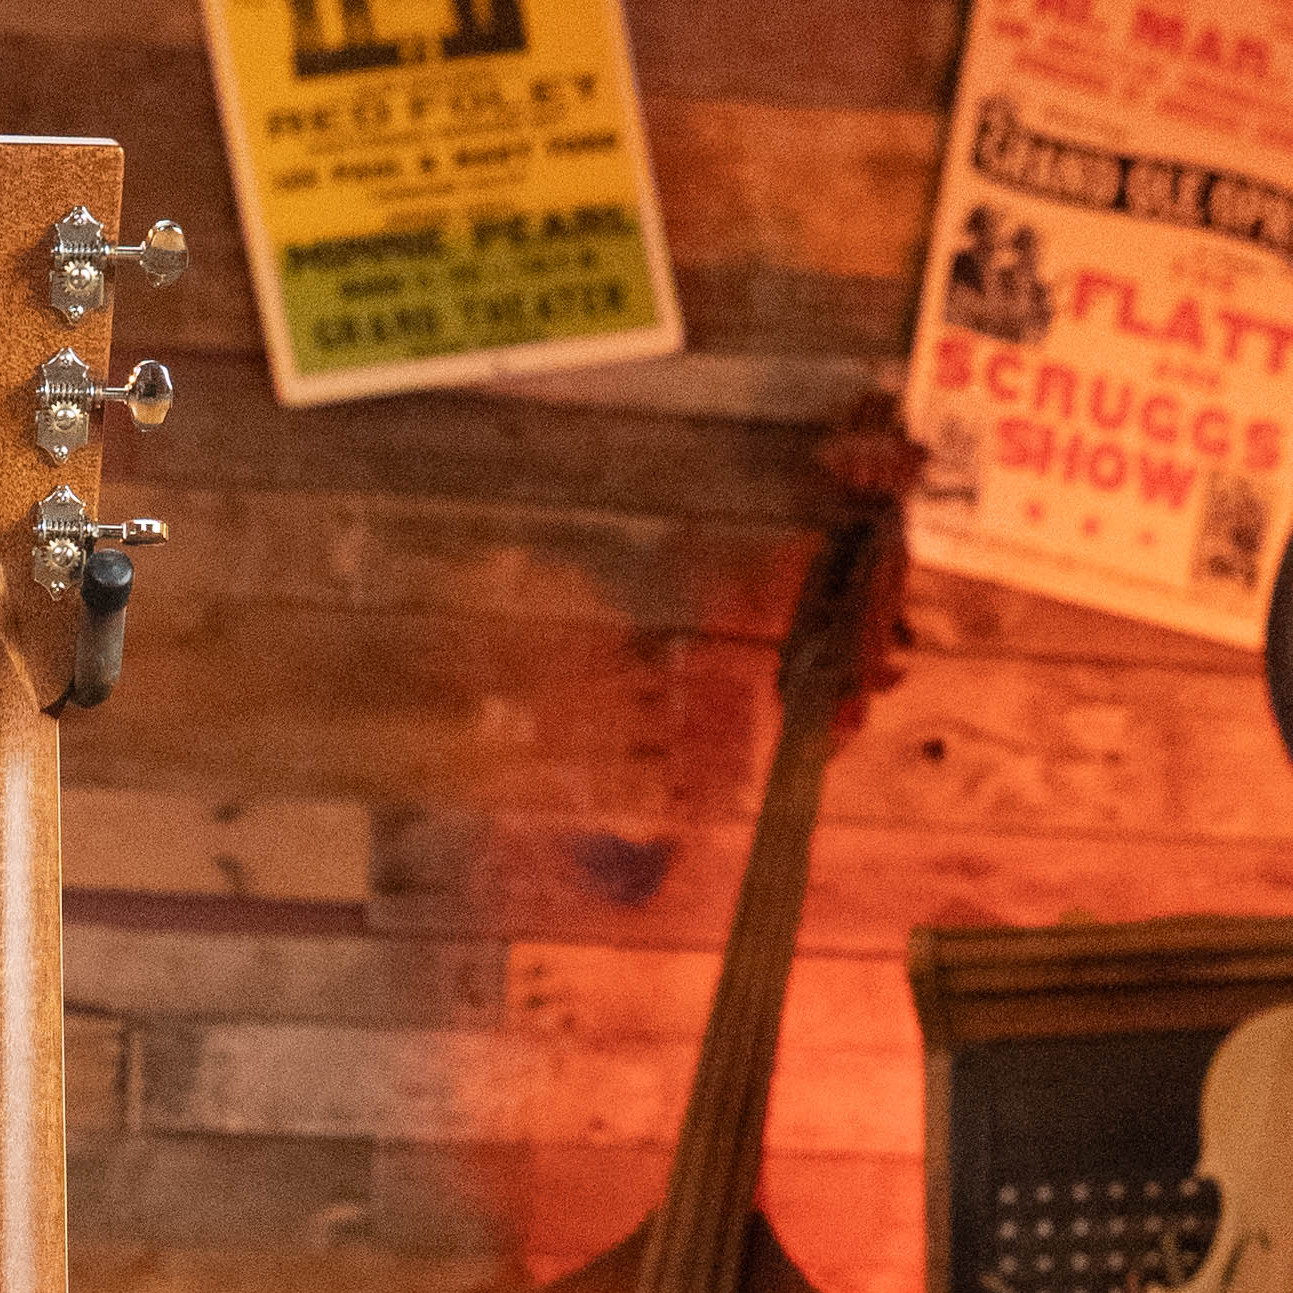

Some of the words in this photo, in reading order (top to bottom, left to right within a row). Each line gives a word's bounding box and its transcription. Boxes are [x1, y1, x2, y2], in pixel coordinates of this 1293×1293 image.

[407, 70, 601, 124] FOLEY
[1069, 268, 1293, 375] FLATT
[935, 334, 1284, 474] SCRUGGS
[996, 416, 1199, 512] SHOW
